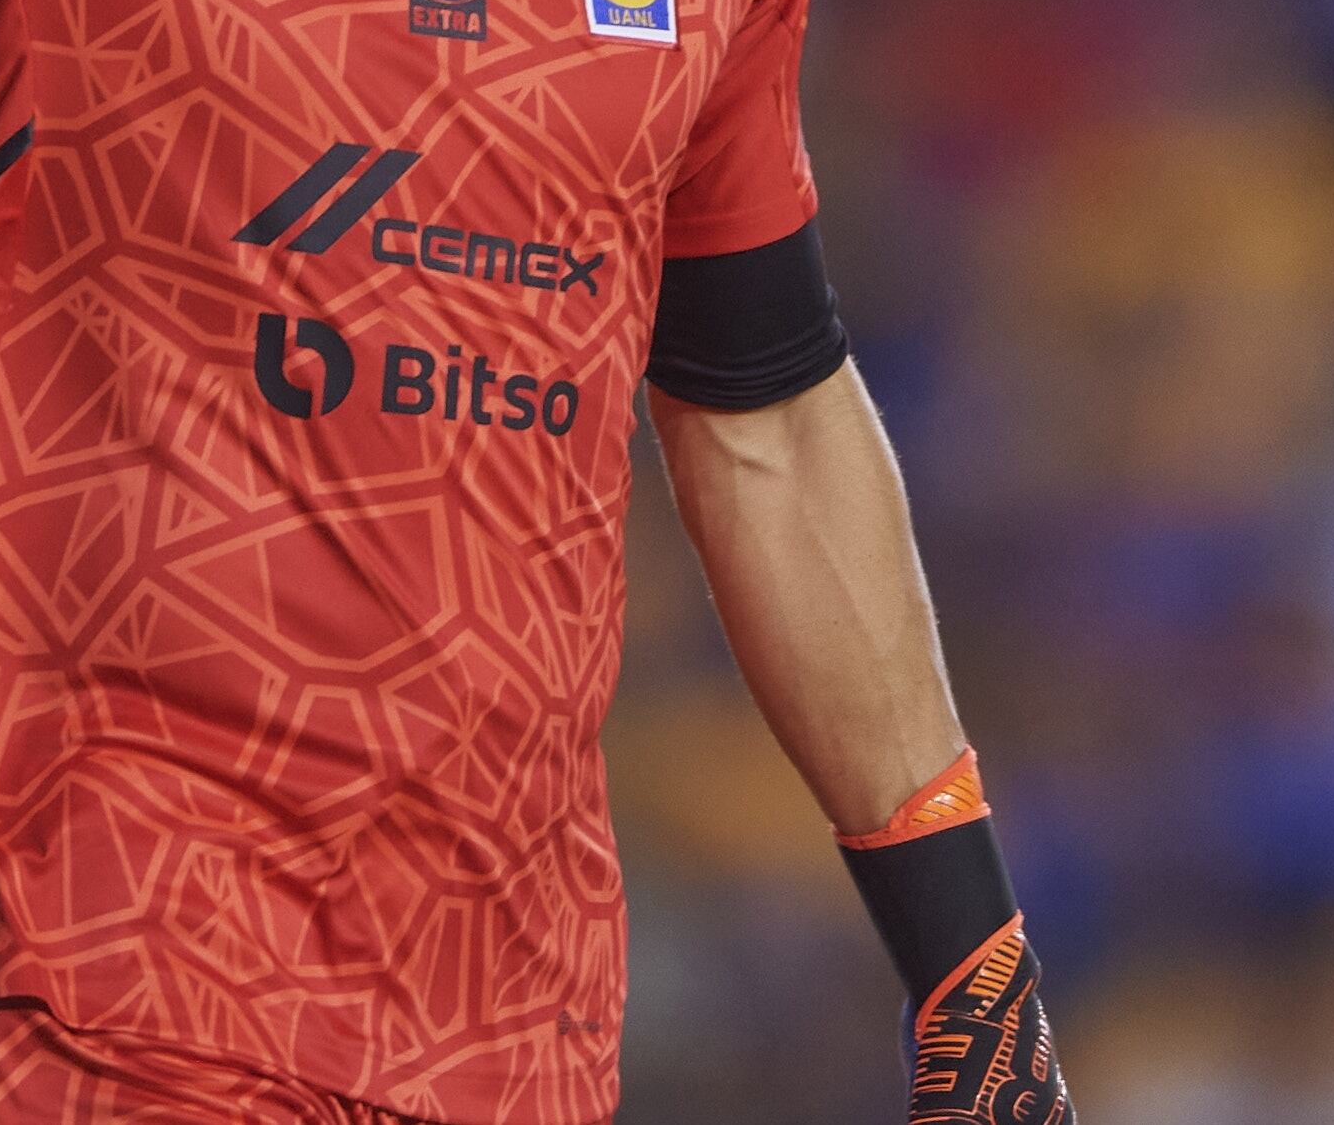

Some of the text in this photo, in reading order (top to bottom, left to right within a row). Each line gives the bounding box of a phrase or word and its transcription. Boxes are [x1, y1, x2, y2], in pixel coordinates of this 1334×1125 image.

[413, 6, 481, 32] EXTRA
[607, 8, 657, 28] UANL
[372, 217, 604, 297] CEMEX
[380, 344, 580, 437] Bitso
